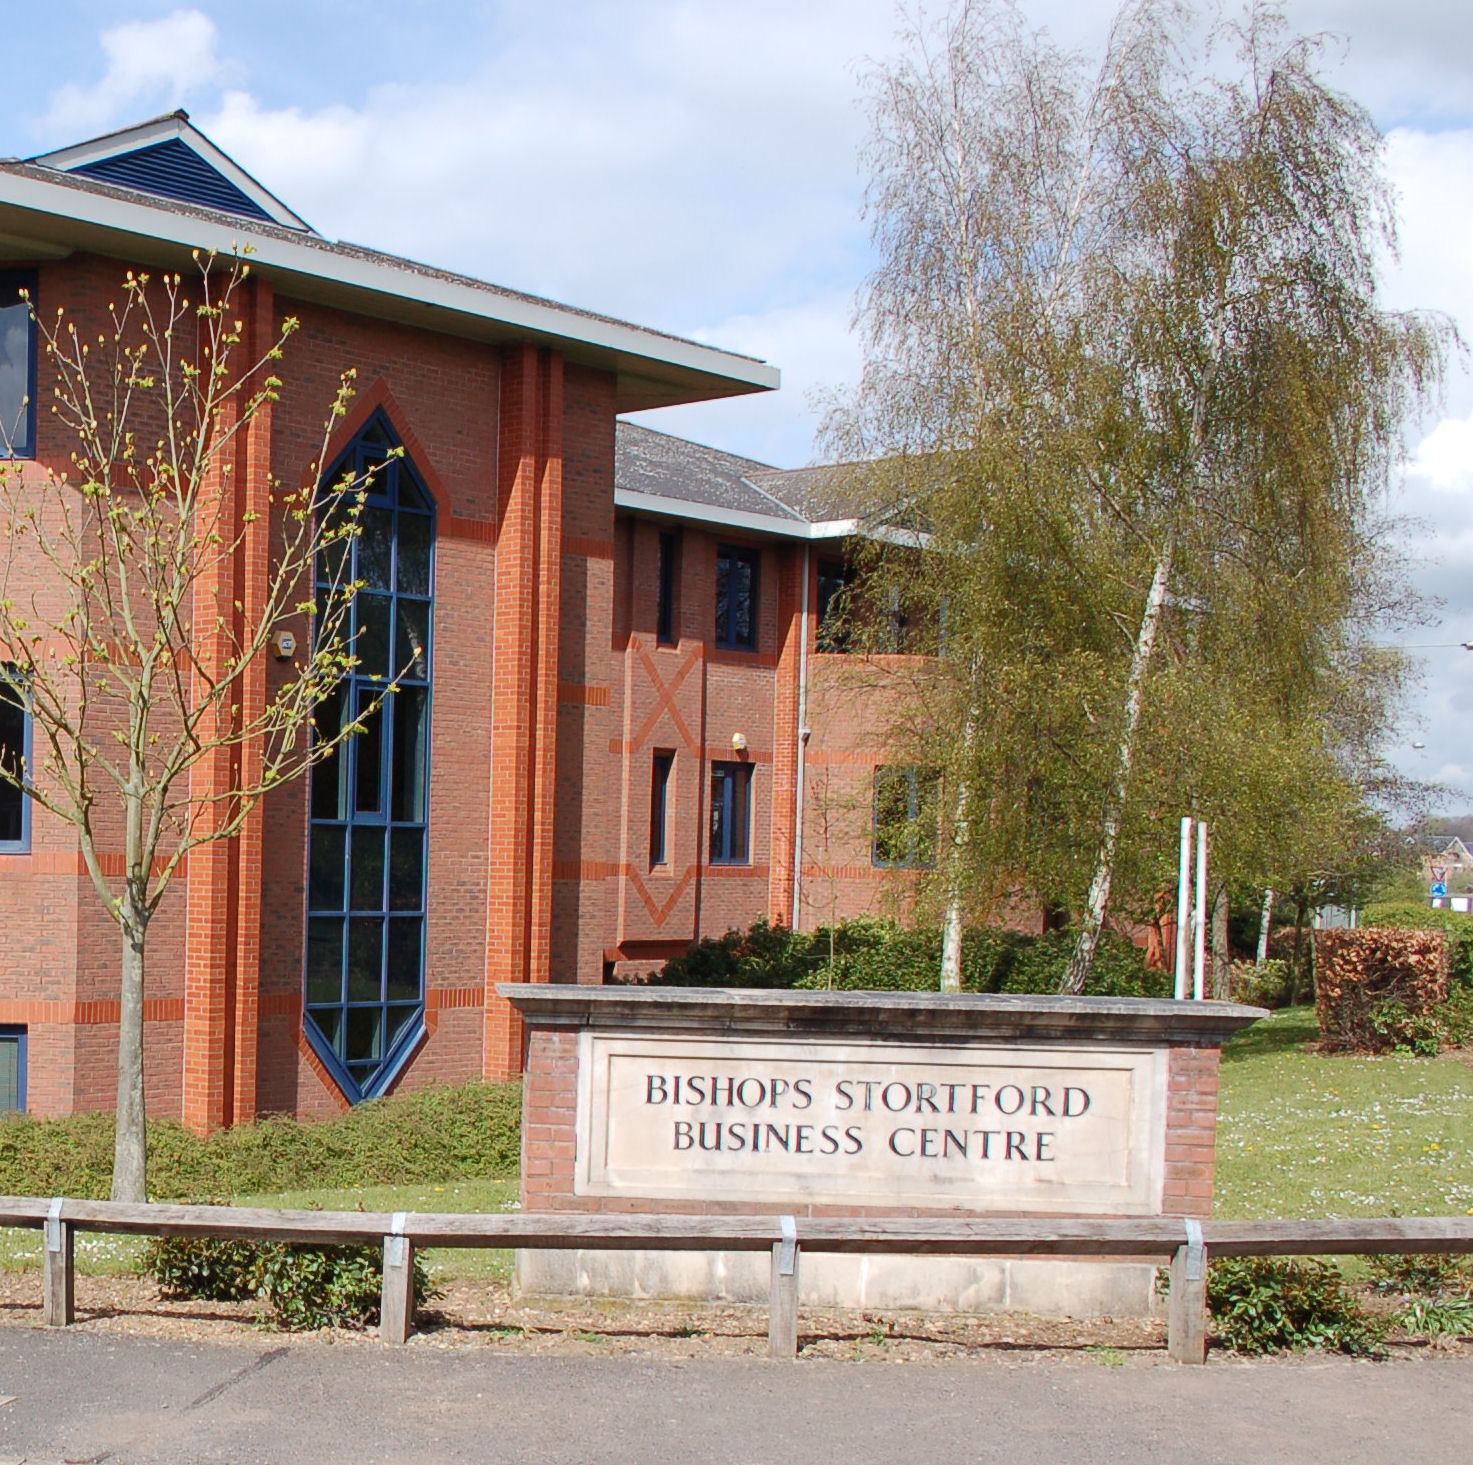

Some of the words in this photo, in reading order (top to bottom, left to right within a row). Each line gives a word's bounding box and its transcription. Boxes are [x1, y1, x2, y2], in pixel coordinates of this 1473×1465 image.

[645, 1074, 813, 1110] BISHOPS
[834, 1079, 1092, 1118] STORTFORD
[672, 1120, 864, 1156] BUSINESS
[888, 1127, 1056, 1162] CENTRE
